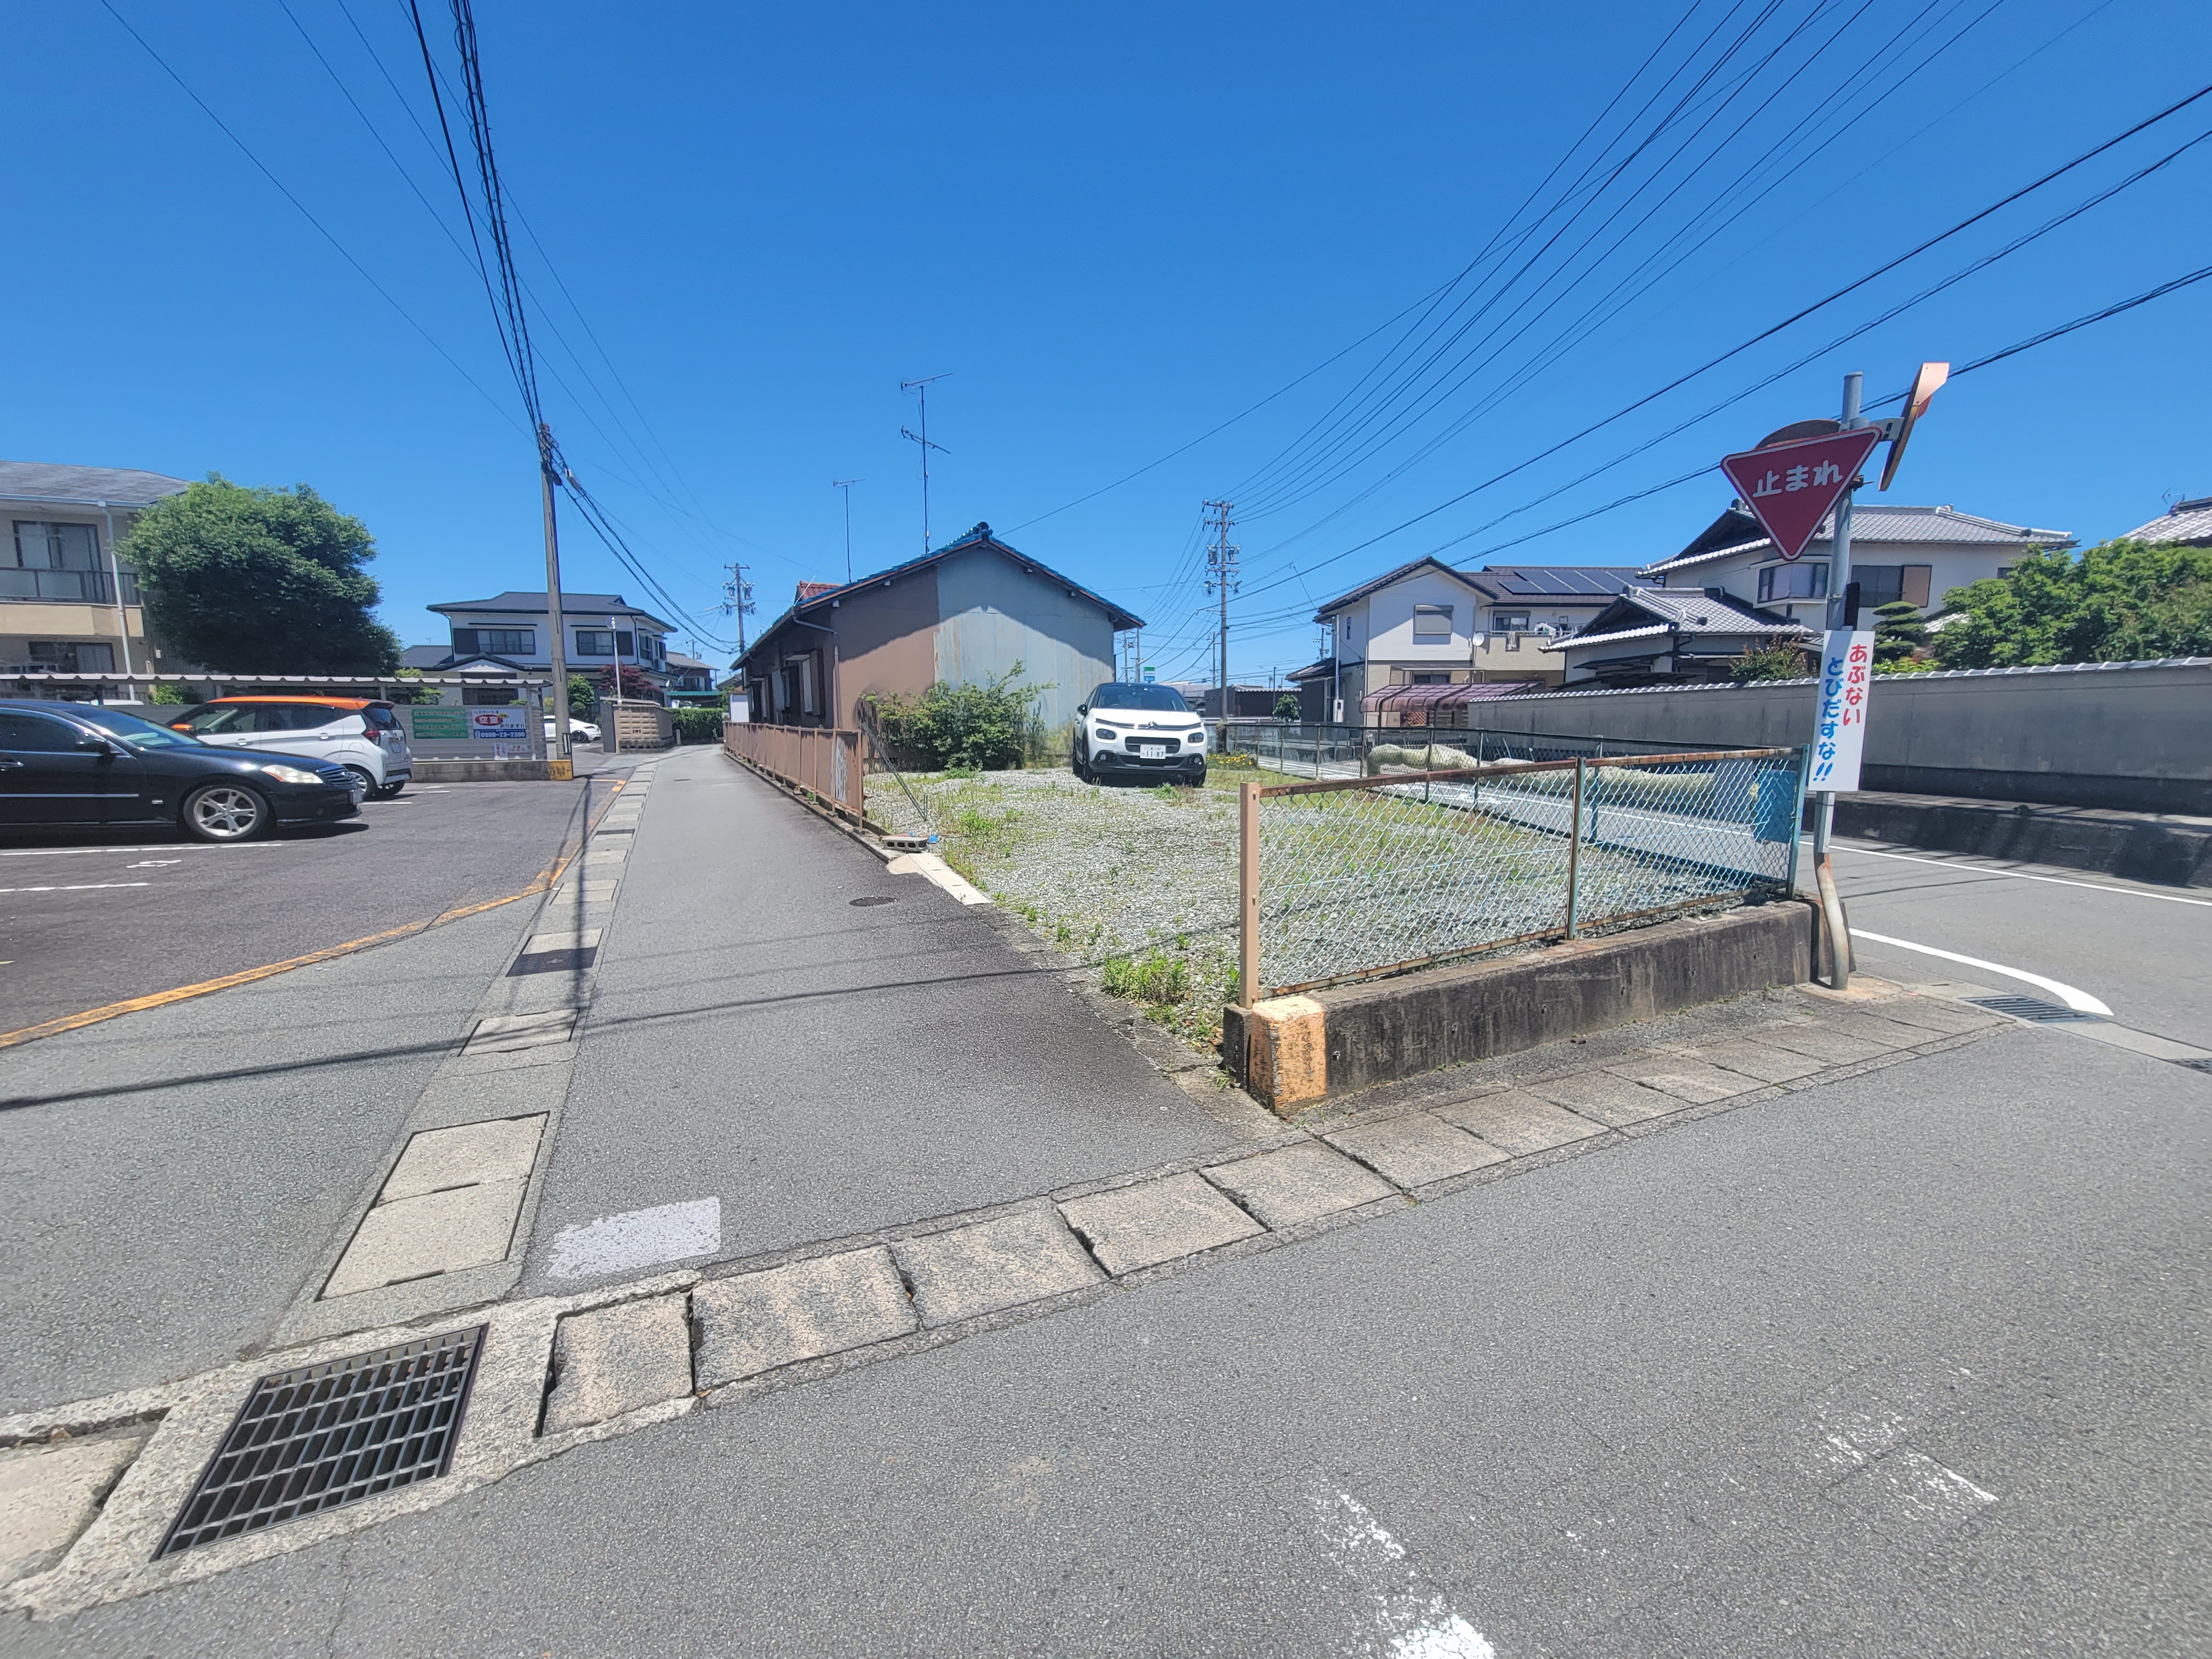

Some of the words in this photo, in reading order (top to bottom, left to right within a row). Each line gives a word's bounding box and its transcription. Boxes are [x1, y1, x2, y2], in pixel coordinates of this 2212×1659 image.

[1752, 460, 1844, 498] 止まれ
[1843, 644, 1868, 726] あぶない
